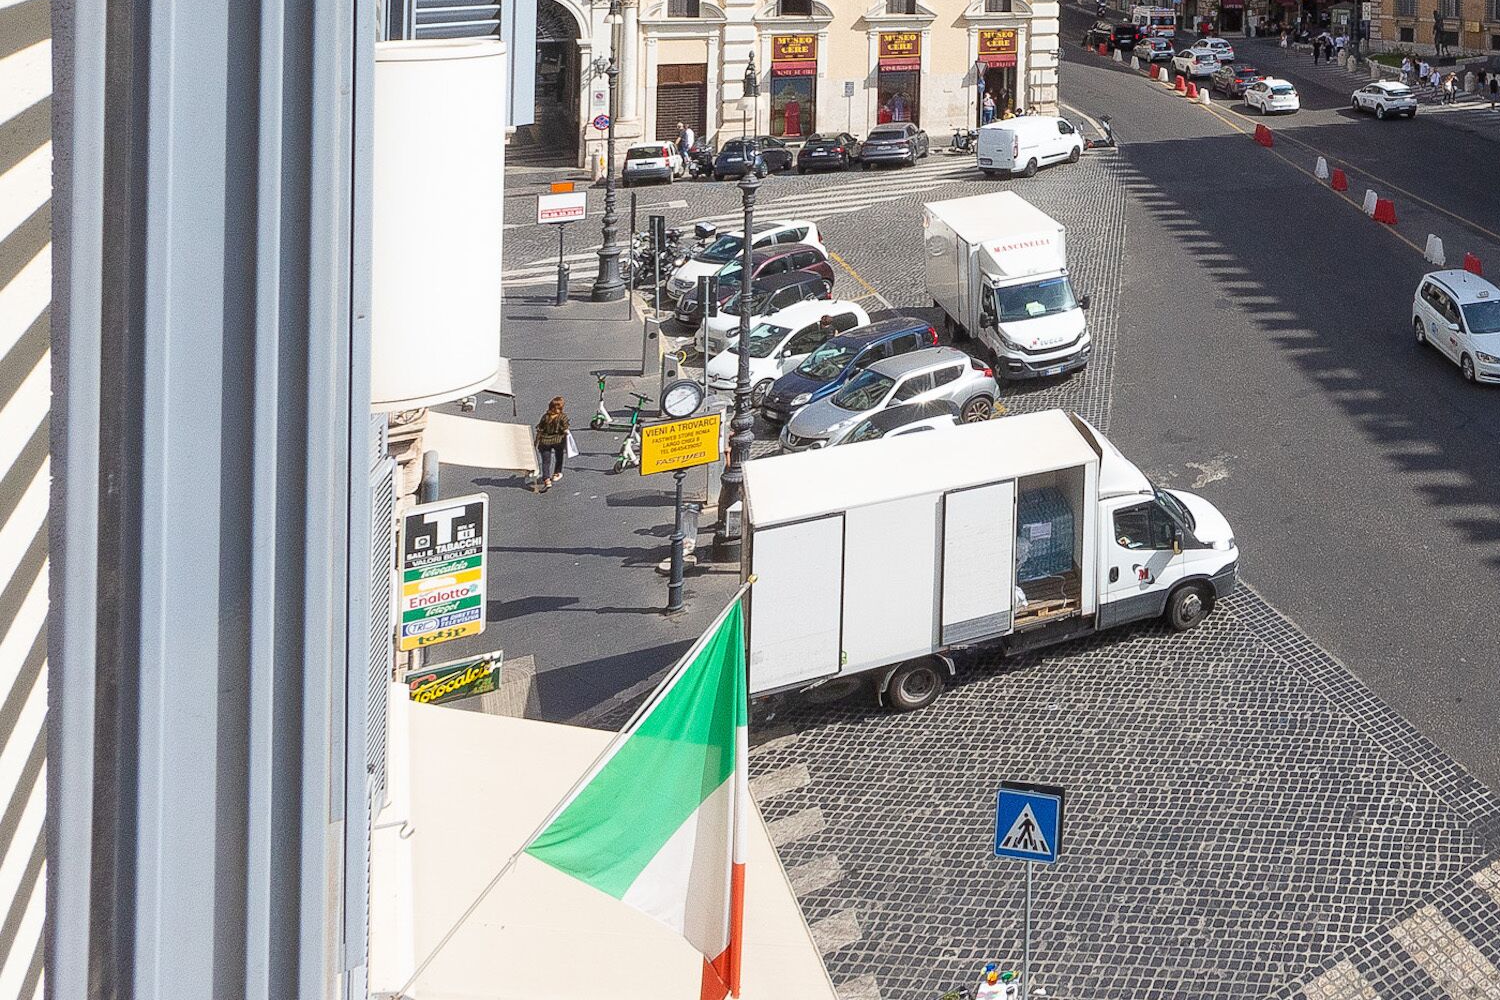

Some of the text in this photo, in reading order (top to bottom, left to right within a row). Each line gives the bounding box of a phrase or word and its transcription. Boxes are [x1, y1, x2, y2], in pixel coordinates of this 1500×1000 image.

[986, 39, 1010, 47] CERE
[993, 239, 1050, 253] MANCINELLI
[1040, 337, 1064, 346] IVECO
[646, 417, 717, 437] VIENI A TROVARCI
[678, 431, 696, 439] STORE
[656, 451, 706, 465] FASTWEB
[423, 505, 466, 545] T
[407, 551, 426, 561] SALI
[435, 536, 482, 554] TABACCHI
[412, 549, 477, 567] VALORI BOLLATI
[419, 560, 468, 579] Totocalcio
[1138, 567, 1149, 581] M
[409, 587, 470, 609] Enalotto
[424, 601, 461, 617] Totogol
[451, 609, 479, 620] DIRETTA
[440, 614, 479, 628] TELEVISIVA
[418, 627, 467, 645] totip
